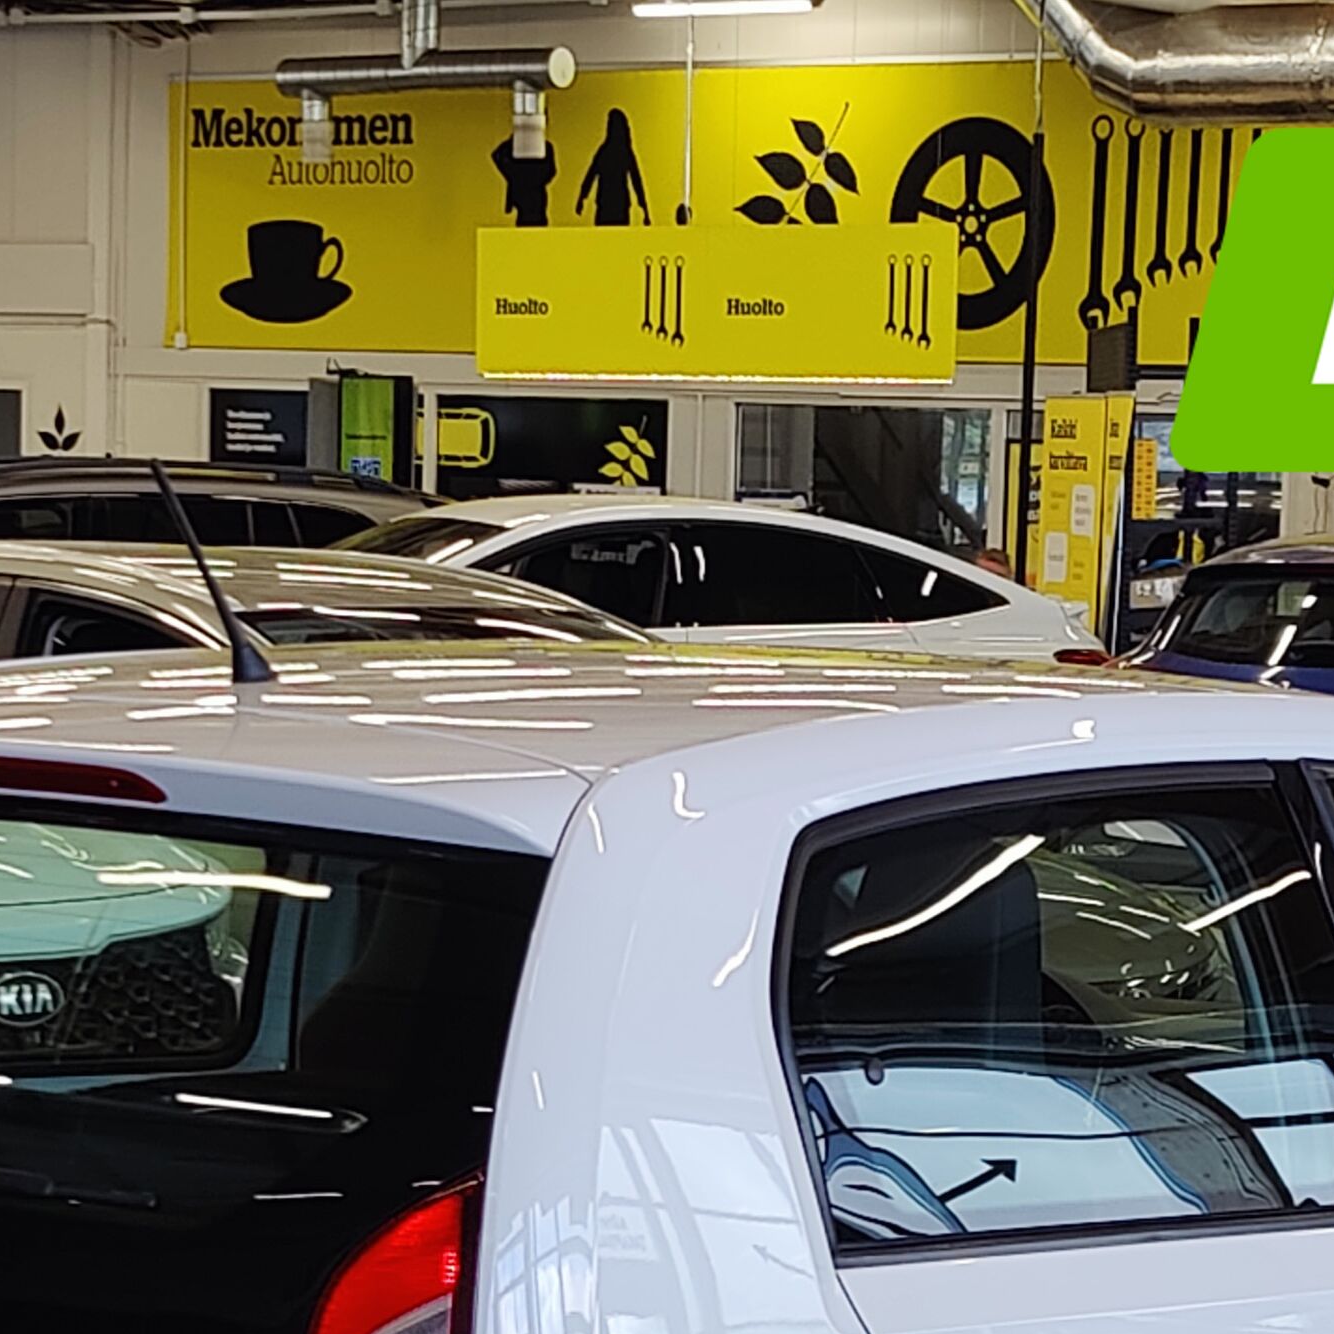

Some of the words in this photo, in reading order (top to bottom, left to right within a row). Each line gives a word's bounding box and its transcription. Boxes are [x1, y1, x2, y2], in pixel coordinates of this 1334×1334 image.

[191, 108, 414, 148] Mekonmen
[268, 153, 414, 185] Autohuolto
[495, 298, 549, 316] Huolto
[726, 298, 785, 317] Huolto
